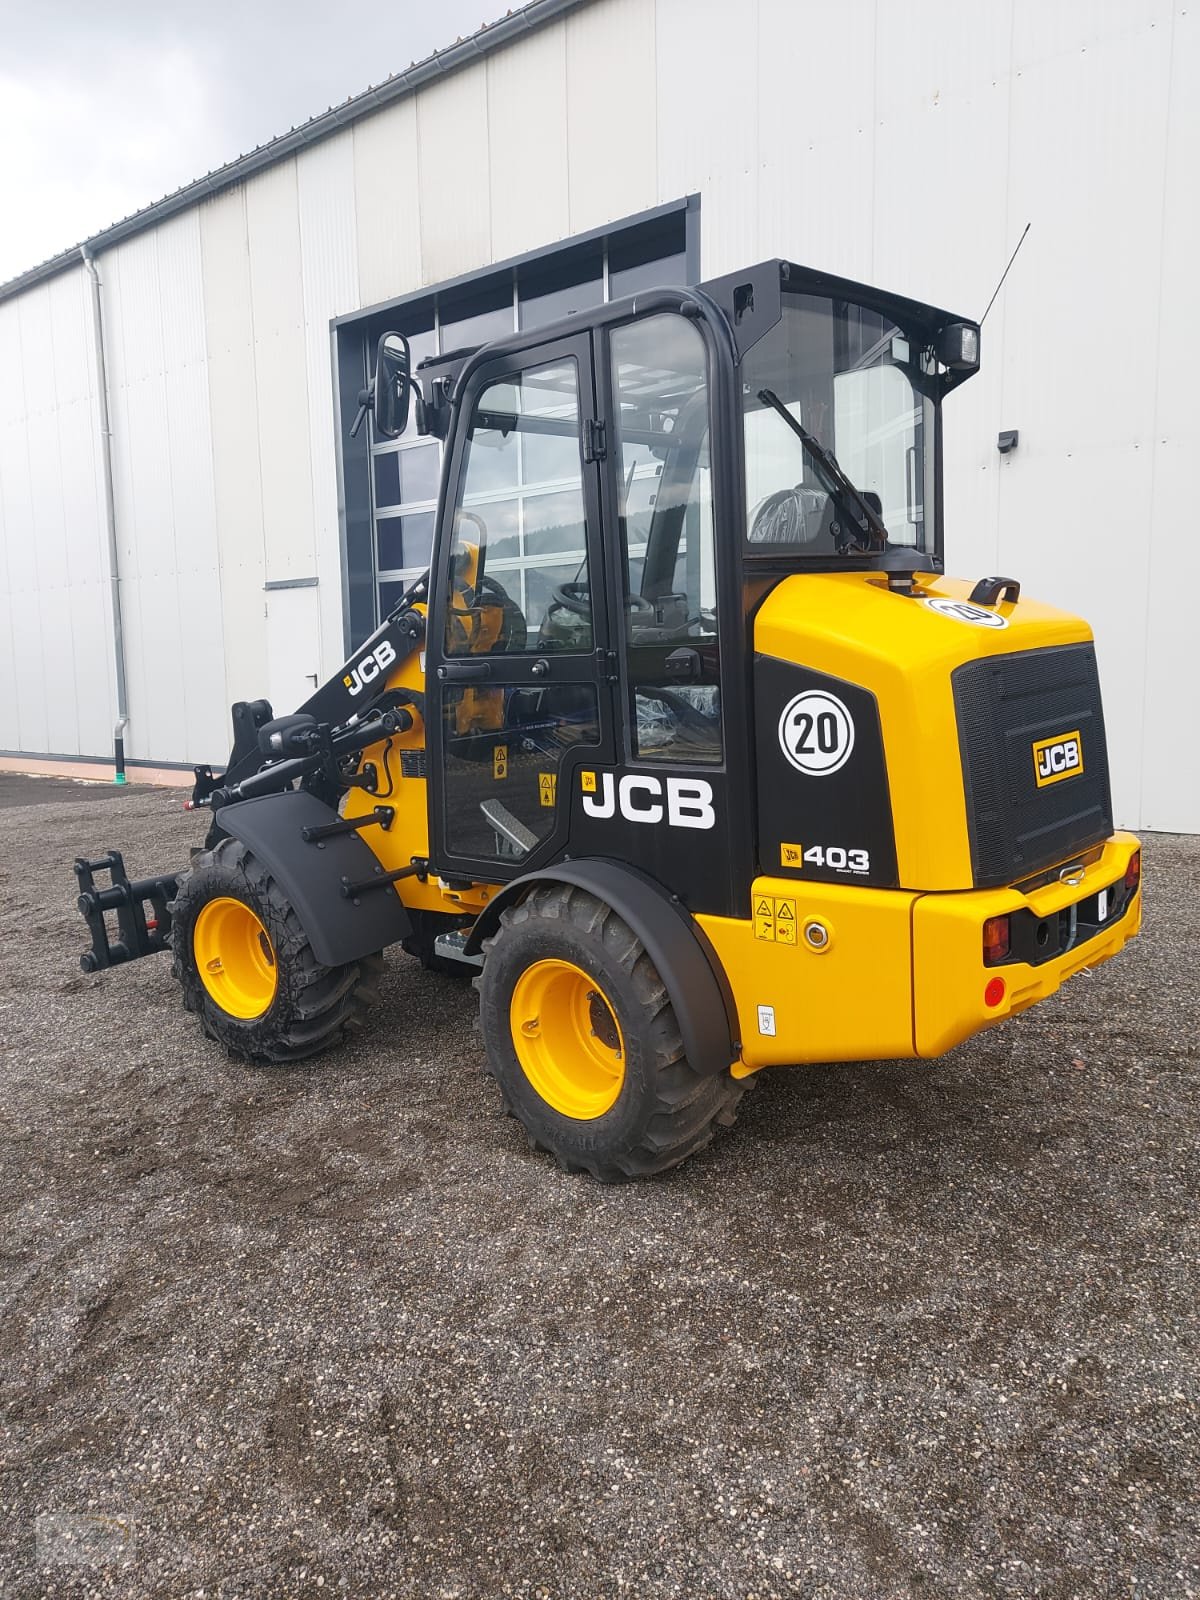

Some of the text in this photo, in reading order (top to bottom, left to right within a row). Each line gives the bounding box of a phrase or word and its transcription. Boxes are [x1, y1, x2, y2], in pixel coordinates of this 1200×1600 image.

[940, 604, 992, 620] 20
[348, 640, 396, 696] JCB
[793, 712, 838, 754] 20
[1039, 741, 1079, 776] JCB
[582, 773, 715, 829] JCB
[803, 846, 869, 870] 403
